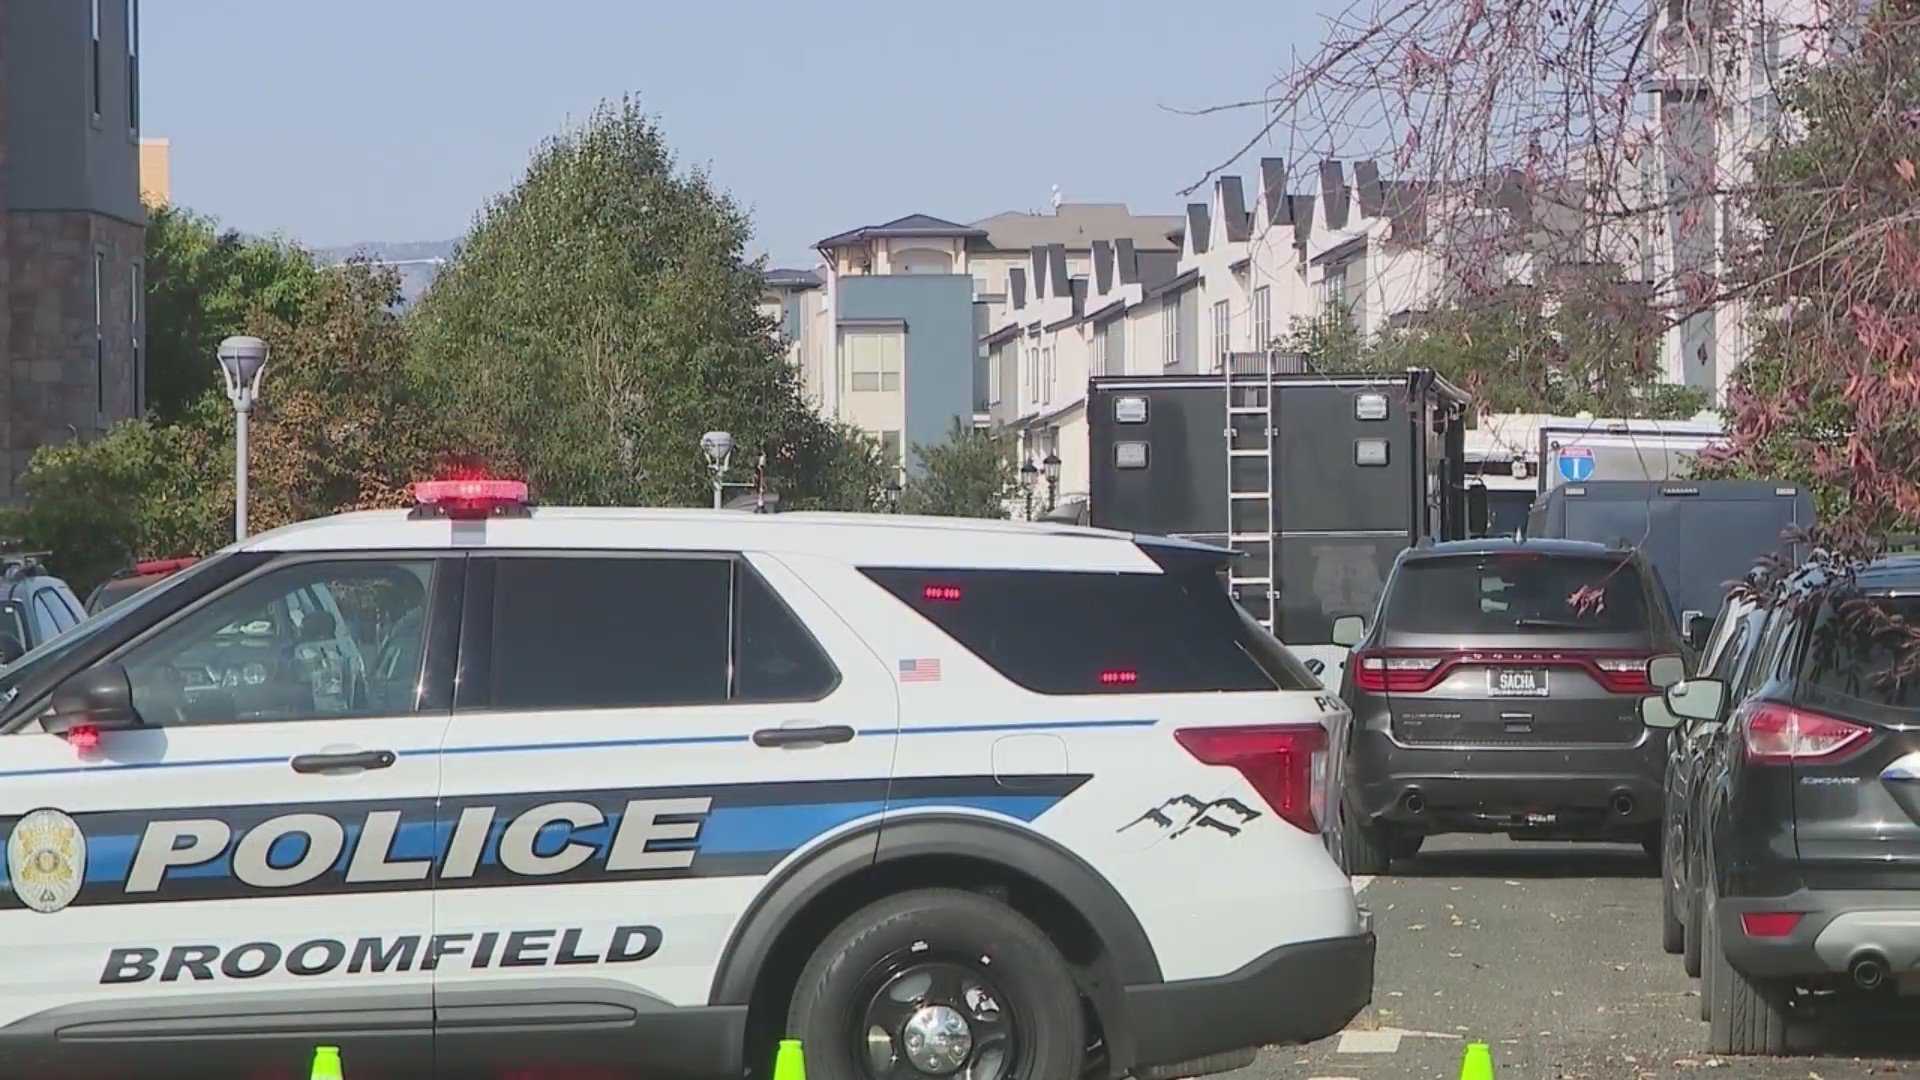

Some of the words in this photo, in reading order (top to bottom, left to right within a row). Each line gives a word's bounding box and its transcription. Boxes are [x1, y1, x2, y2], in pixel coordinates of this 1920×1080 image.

[1500, 673, 1536, 690] SACHA
[1314, 695, 1347, 713] PO
[124, 796, 714, 894] POLICE
[99, 924, 664, 985] BROOMFIELD
